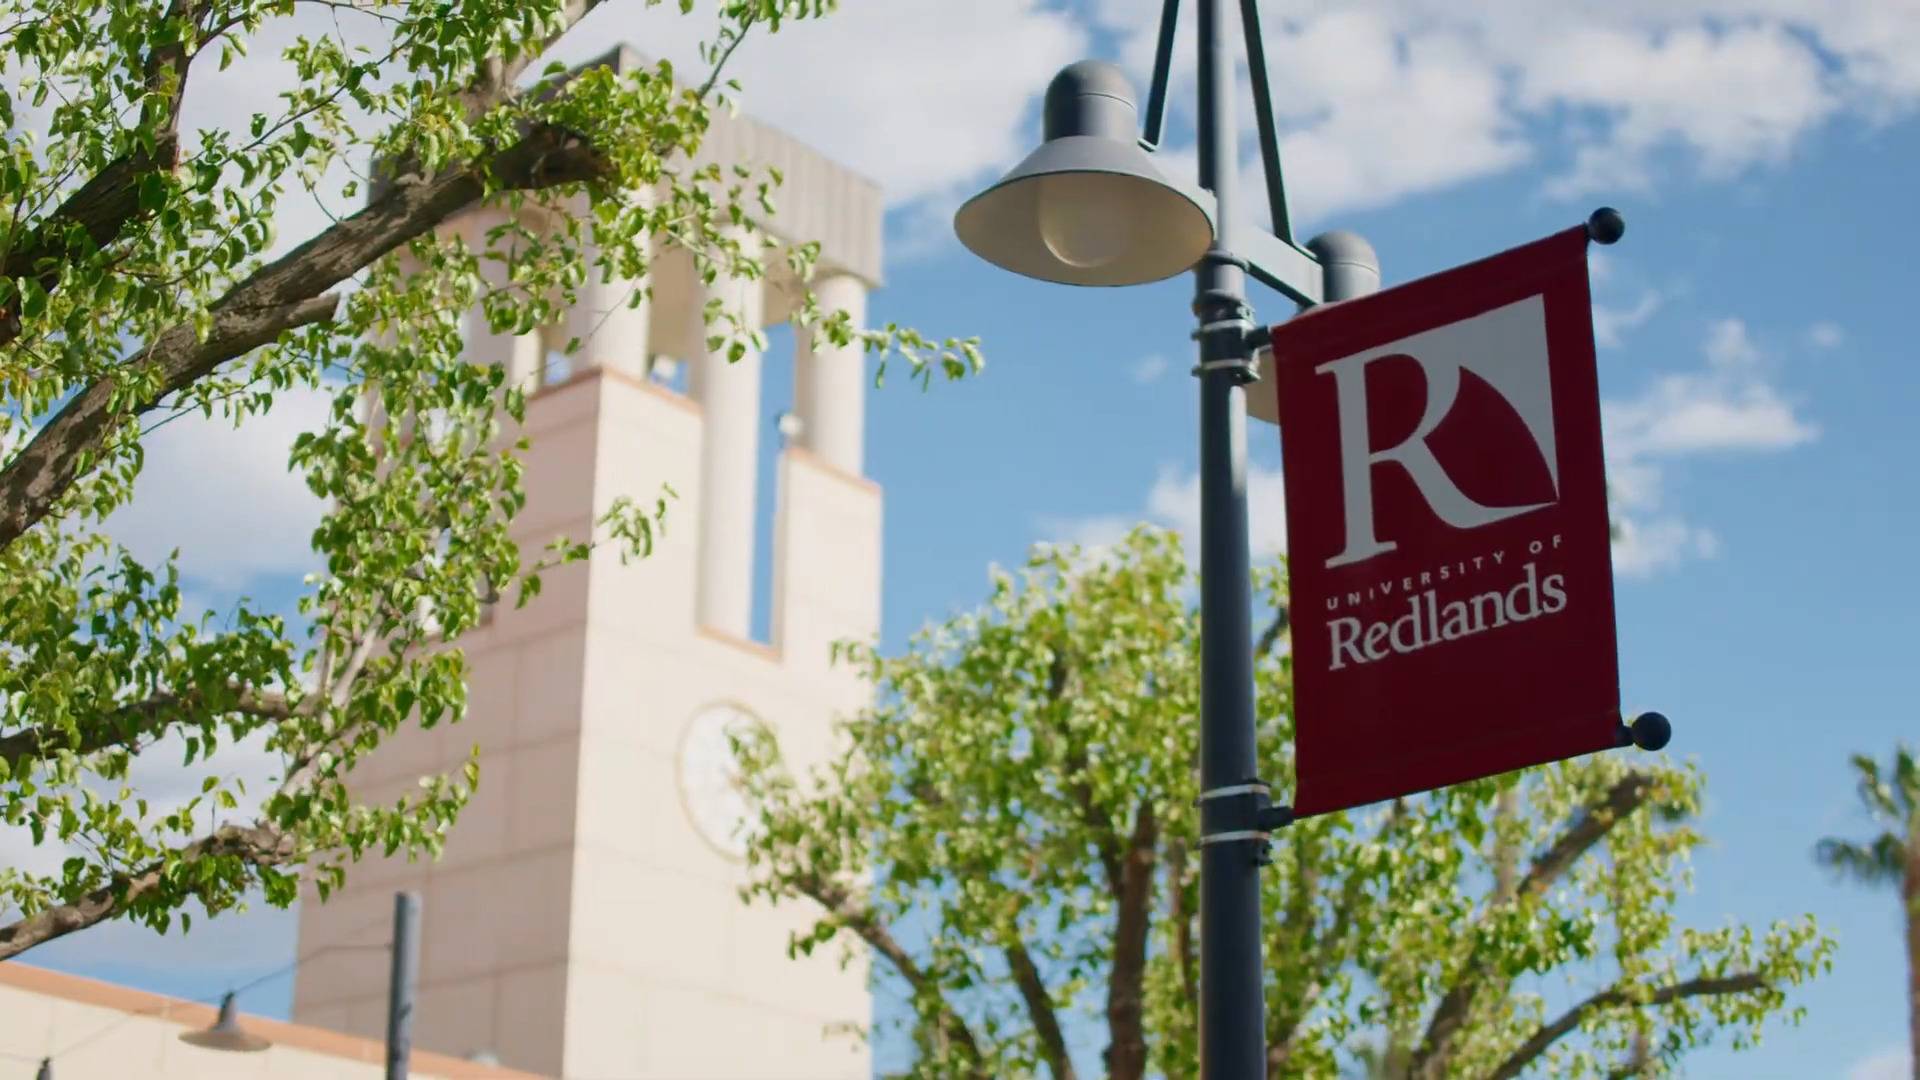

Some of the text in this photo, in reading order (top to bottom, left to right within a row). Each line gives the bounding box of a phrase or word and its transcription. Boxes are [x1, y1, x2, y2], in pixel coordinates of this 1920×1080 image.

[1315, 316, 1558, 569] R
[1326, 562, 1568, 671] Redlands
[1327, 534, 1563, 611] UNIVERSITY OF
